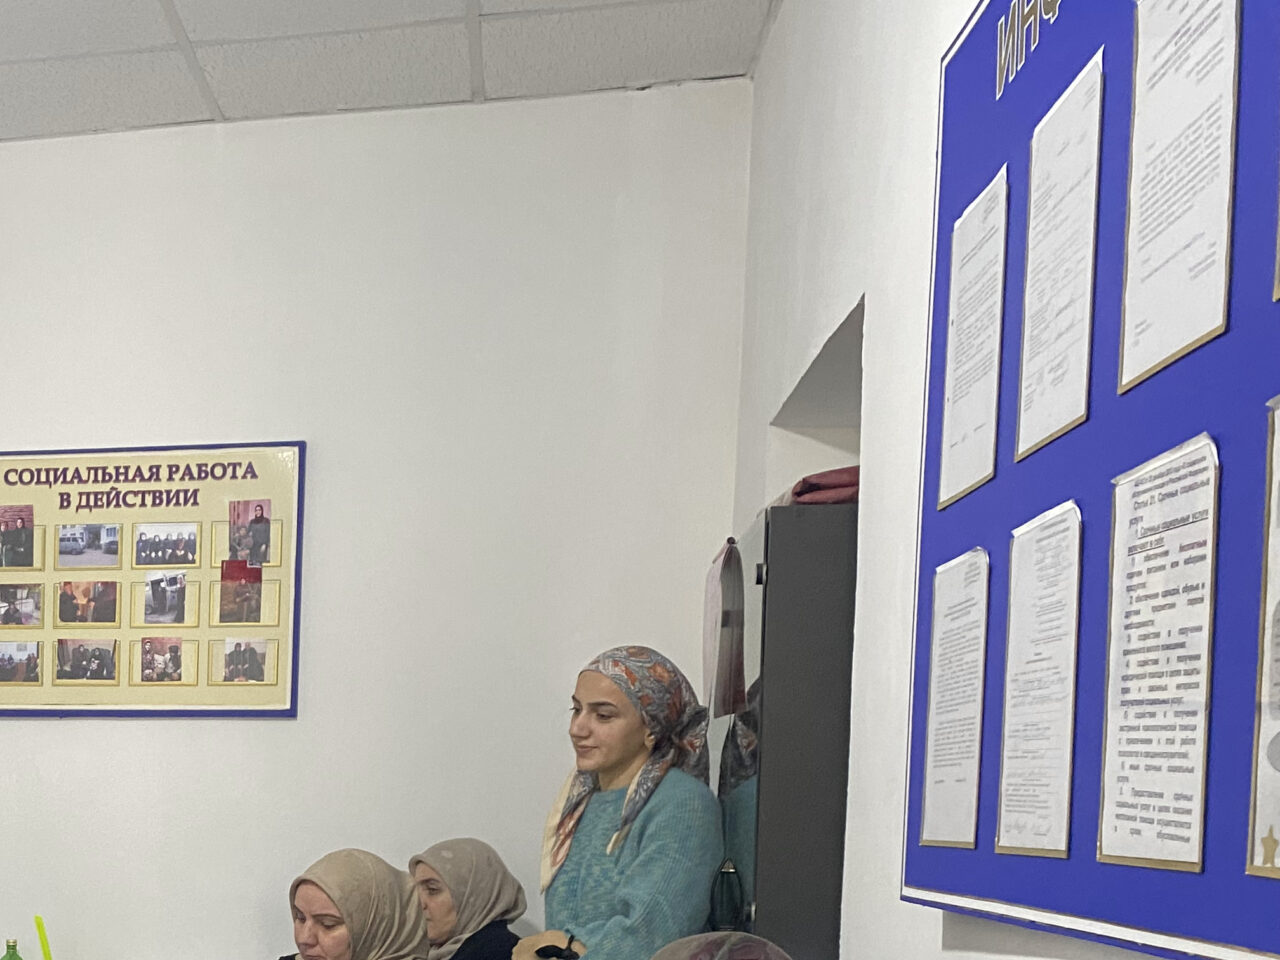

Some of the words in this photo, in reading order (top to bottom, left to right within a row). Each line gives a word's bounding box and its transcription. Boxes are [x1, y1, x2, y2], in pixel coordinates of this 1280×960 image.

[996, 0, 1061, 101] ИН
[3, 464, 162, 489] СОЦИАЛЬНАЯ
[166, 461, 259, 482] РАБОТА
[58, 491, 72, 510] В
[75, 486, 200, 514] ДЕЙСТВИИ
